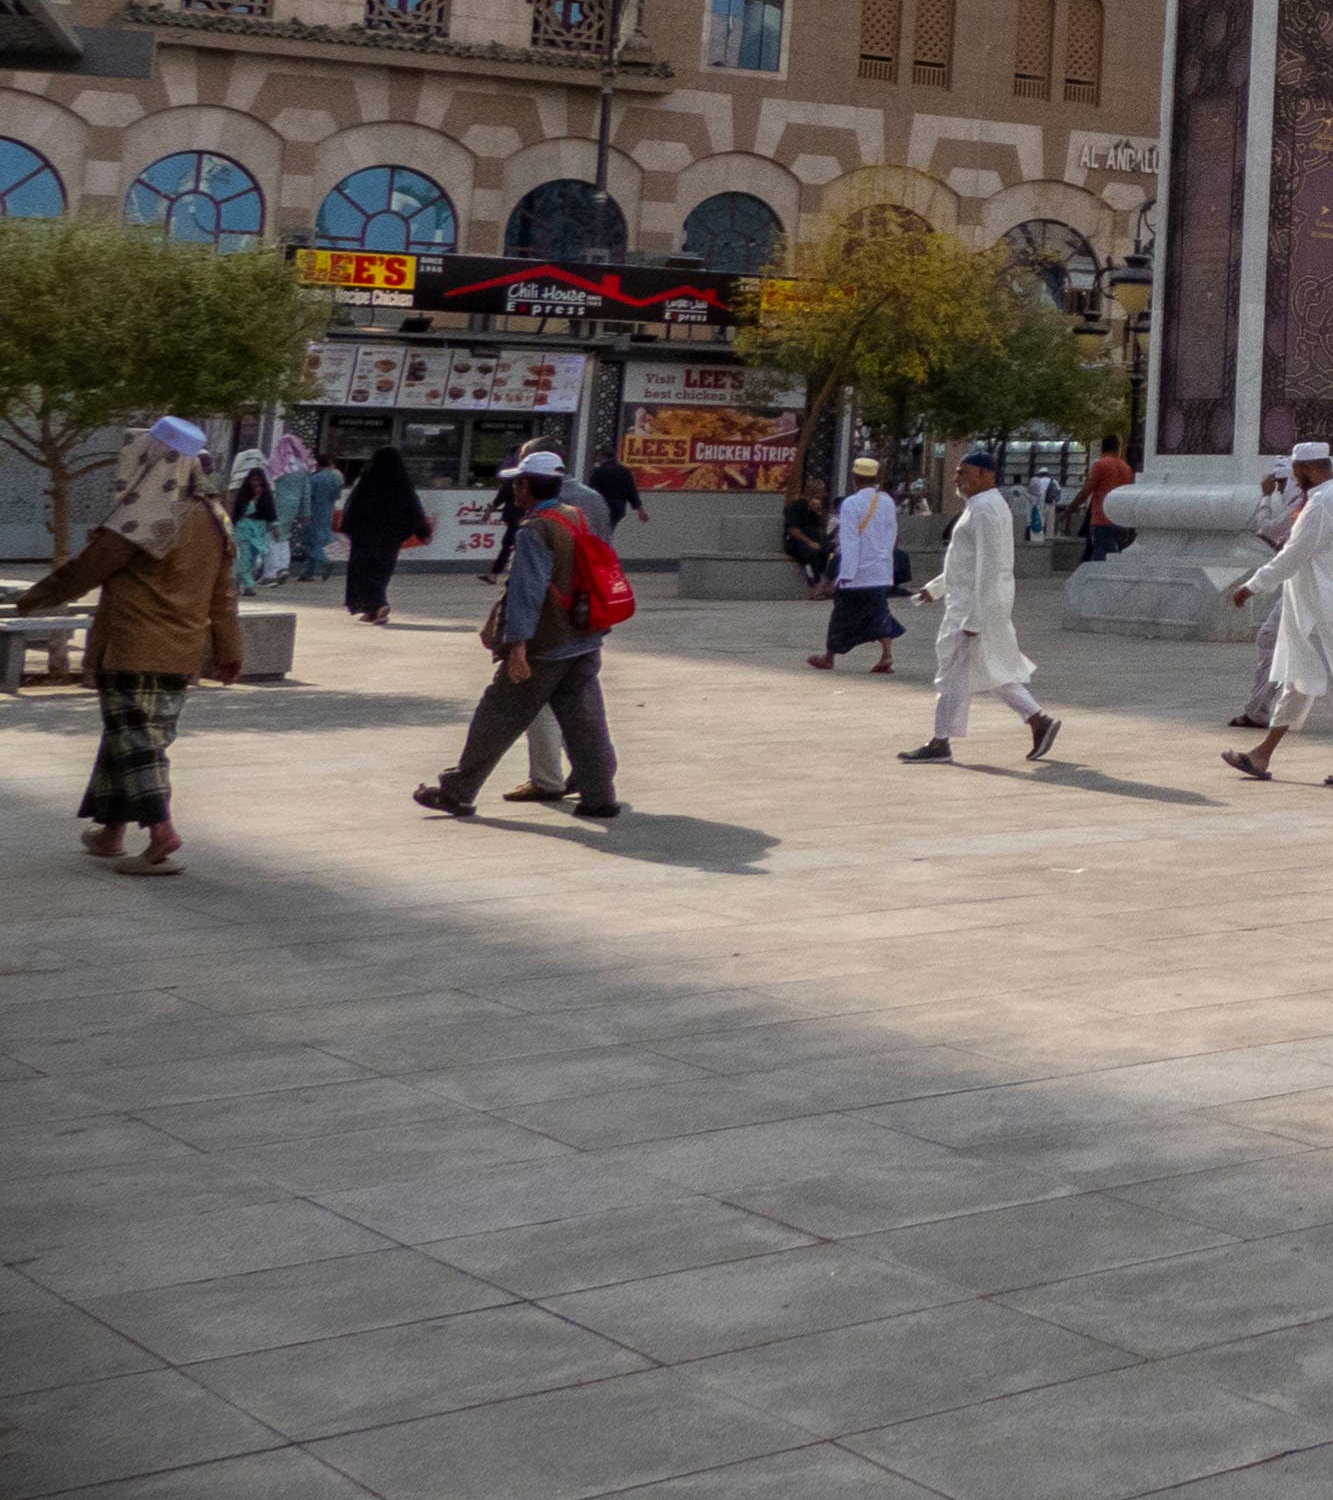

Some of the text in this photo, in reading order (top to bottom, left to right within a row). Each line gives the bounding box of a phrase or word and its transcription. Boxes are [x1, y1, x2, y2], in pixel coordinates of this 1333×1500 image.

[1080, 143, 1098, 169] AL
[507, 281, 539, 299] Chili
[542, 285, 587, 302] House
[644, 373, 677, 384] Visit
[683, 369, 745, 390] LEE'S
[643, 388, 672, 399] best
[675, 389, 727, 402] chicken
[628, 438, 688, 458] LEE'S
[469, 532, 495, 549] 35
